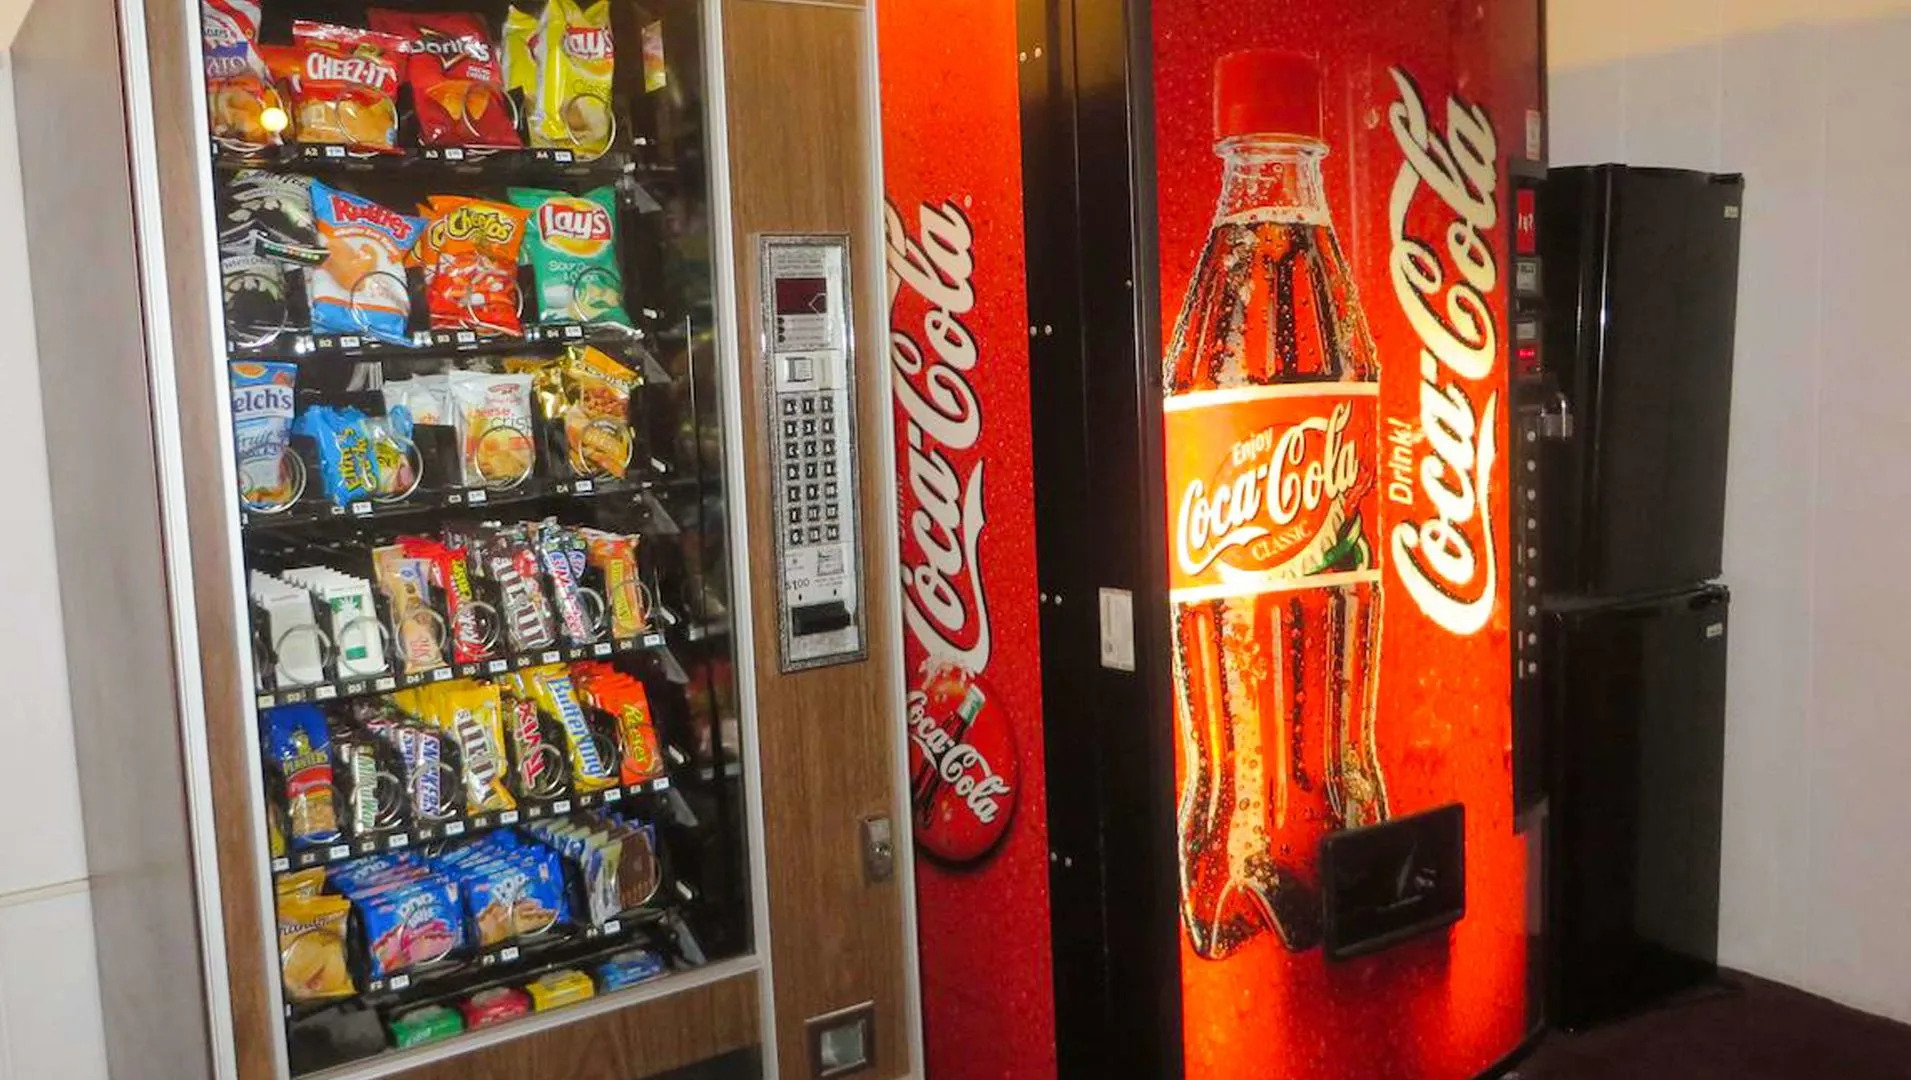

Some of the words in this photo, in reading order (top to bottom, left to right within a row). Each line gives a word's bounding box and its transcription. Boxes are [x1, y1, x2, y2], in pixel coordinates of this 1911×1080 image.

[306, 52, 391, 87] CHEEZ-IT
[448, 208, 515, 244] Cheetos
[543, 204, 609, 241] Lay's
[1386, 64, 1498, 636] Coca-Cola
[233, 389, 293, 413] elch's
[1231, 426, 1274, 467] Enjoy
[1386, 416, 1415, 506] Drink!
[1177, 399, 1360, 577] Coca-Cola
[908, 690, 1011, 824] Coca-Cola
